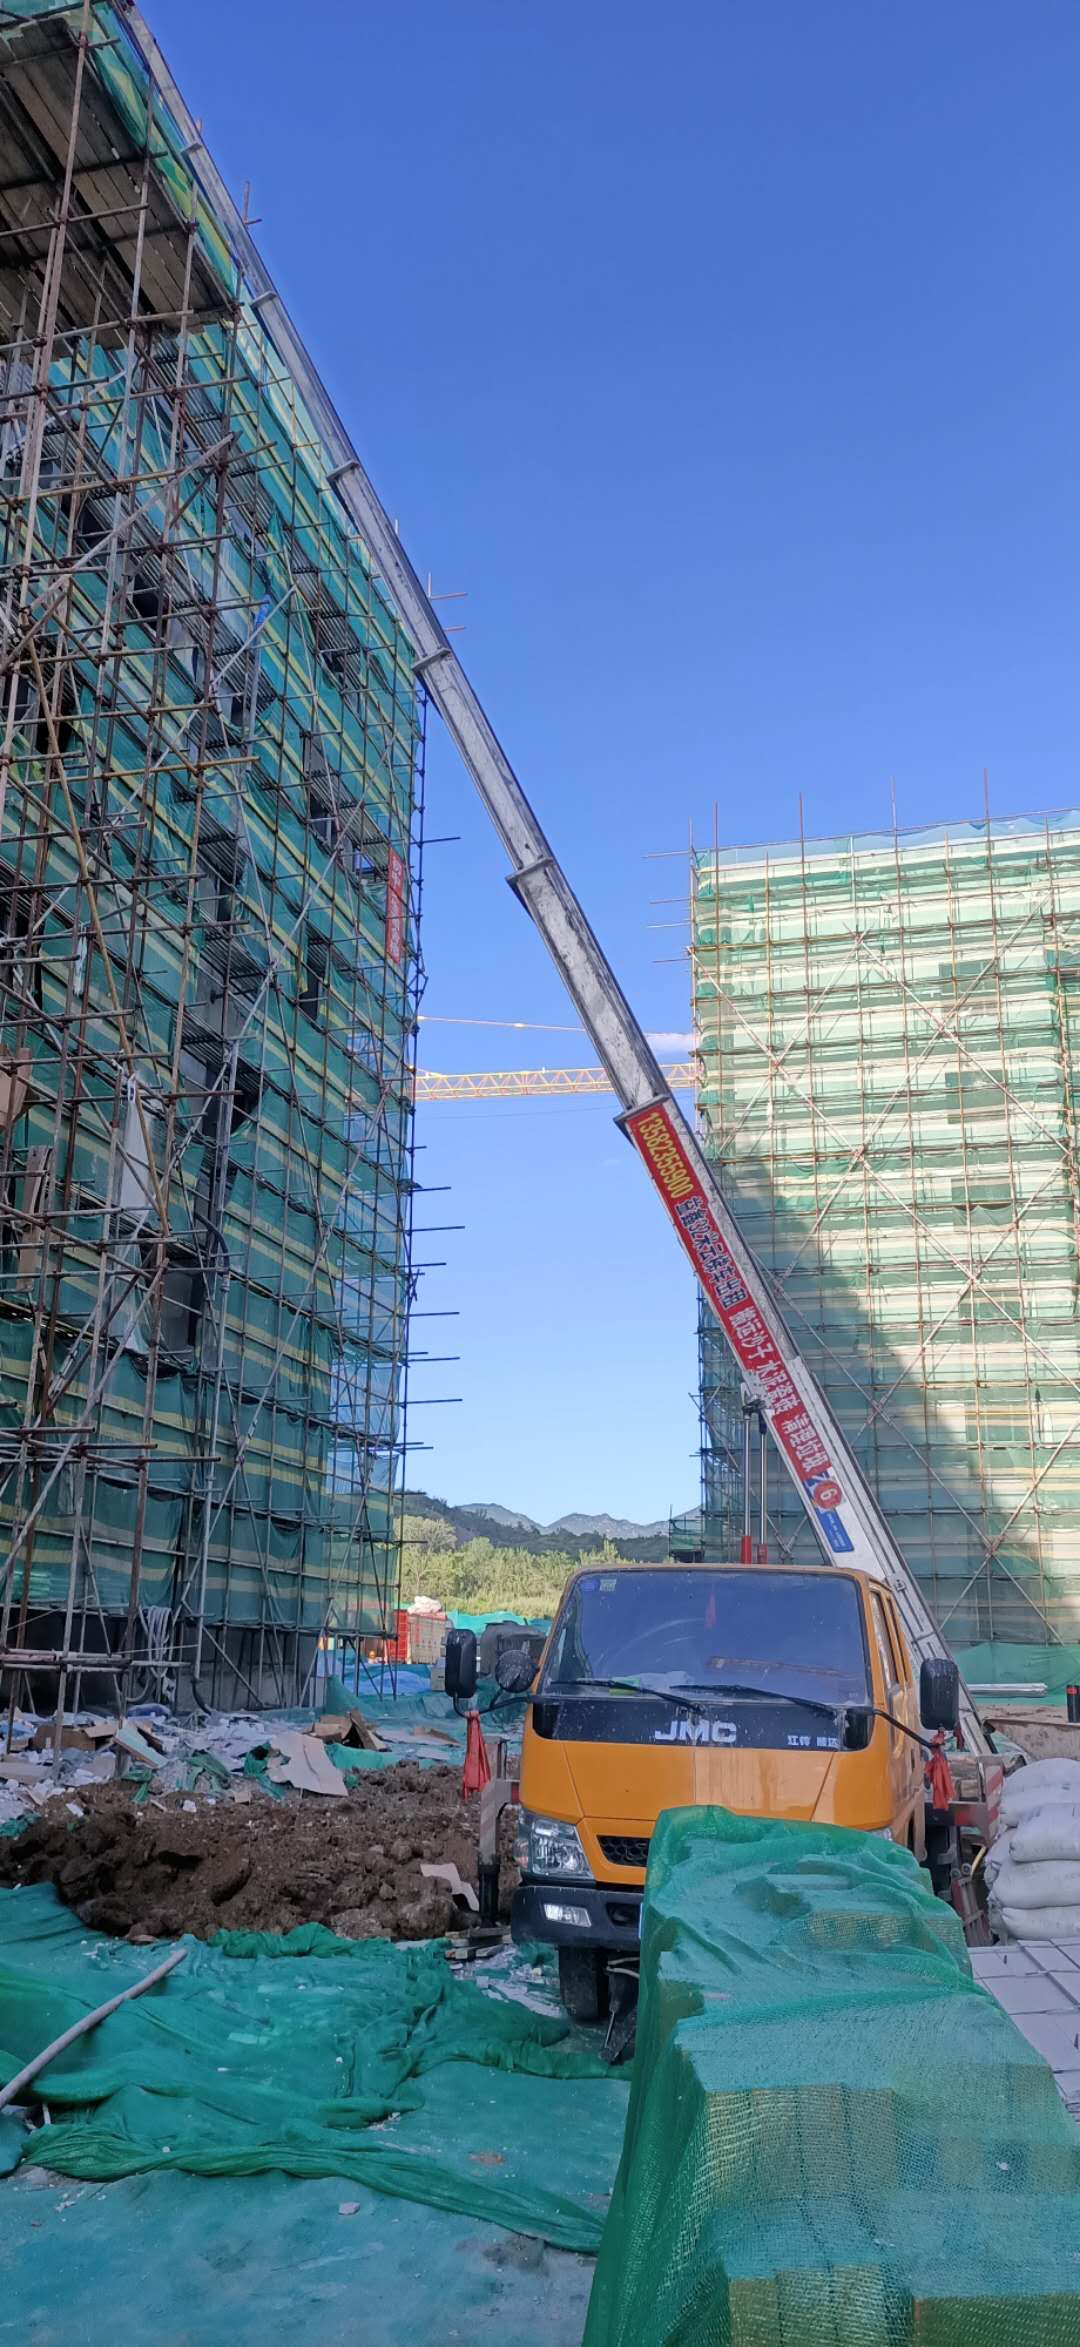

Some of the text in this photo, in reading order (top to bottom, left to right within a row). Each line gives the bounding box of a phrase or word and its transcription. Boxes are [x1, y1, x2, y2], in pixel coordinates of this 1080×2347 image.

[638, 1112, 694, 1199] 13582355900
[782, 1411, 830, 1473] 清理垃圾
[820, 1486, 838, 1501] 6
[655, 1719, 736, 1743] JMC
